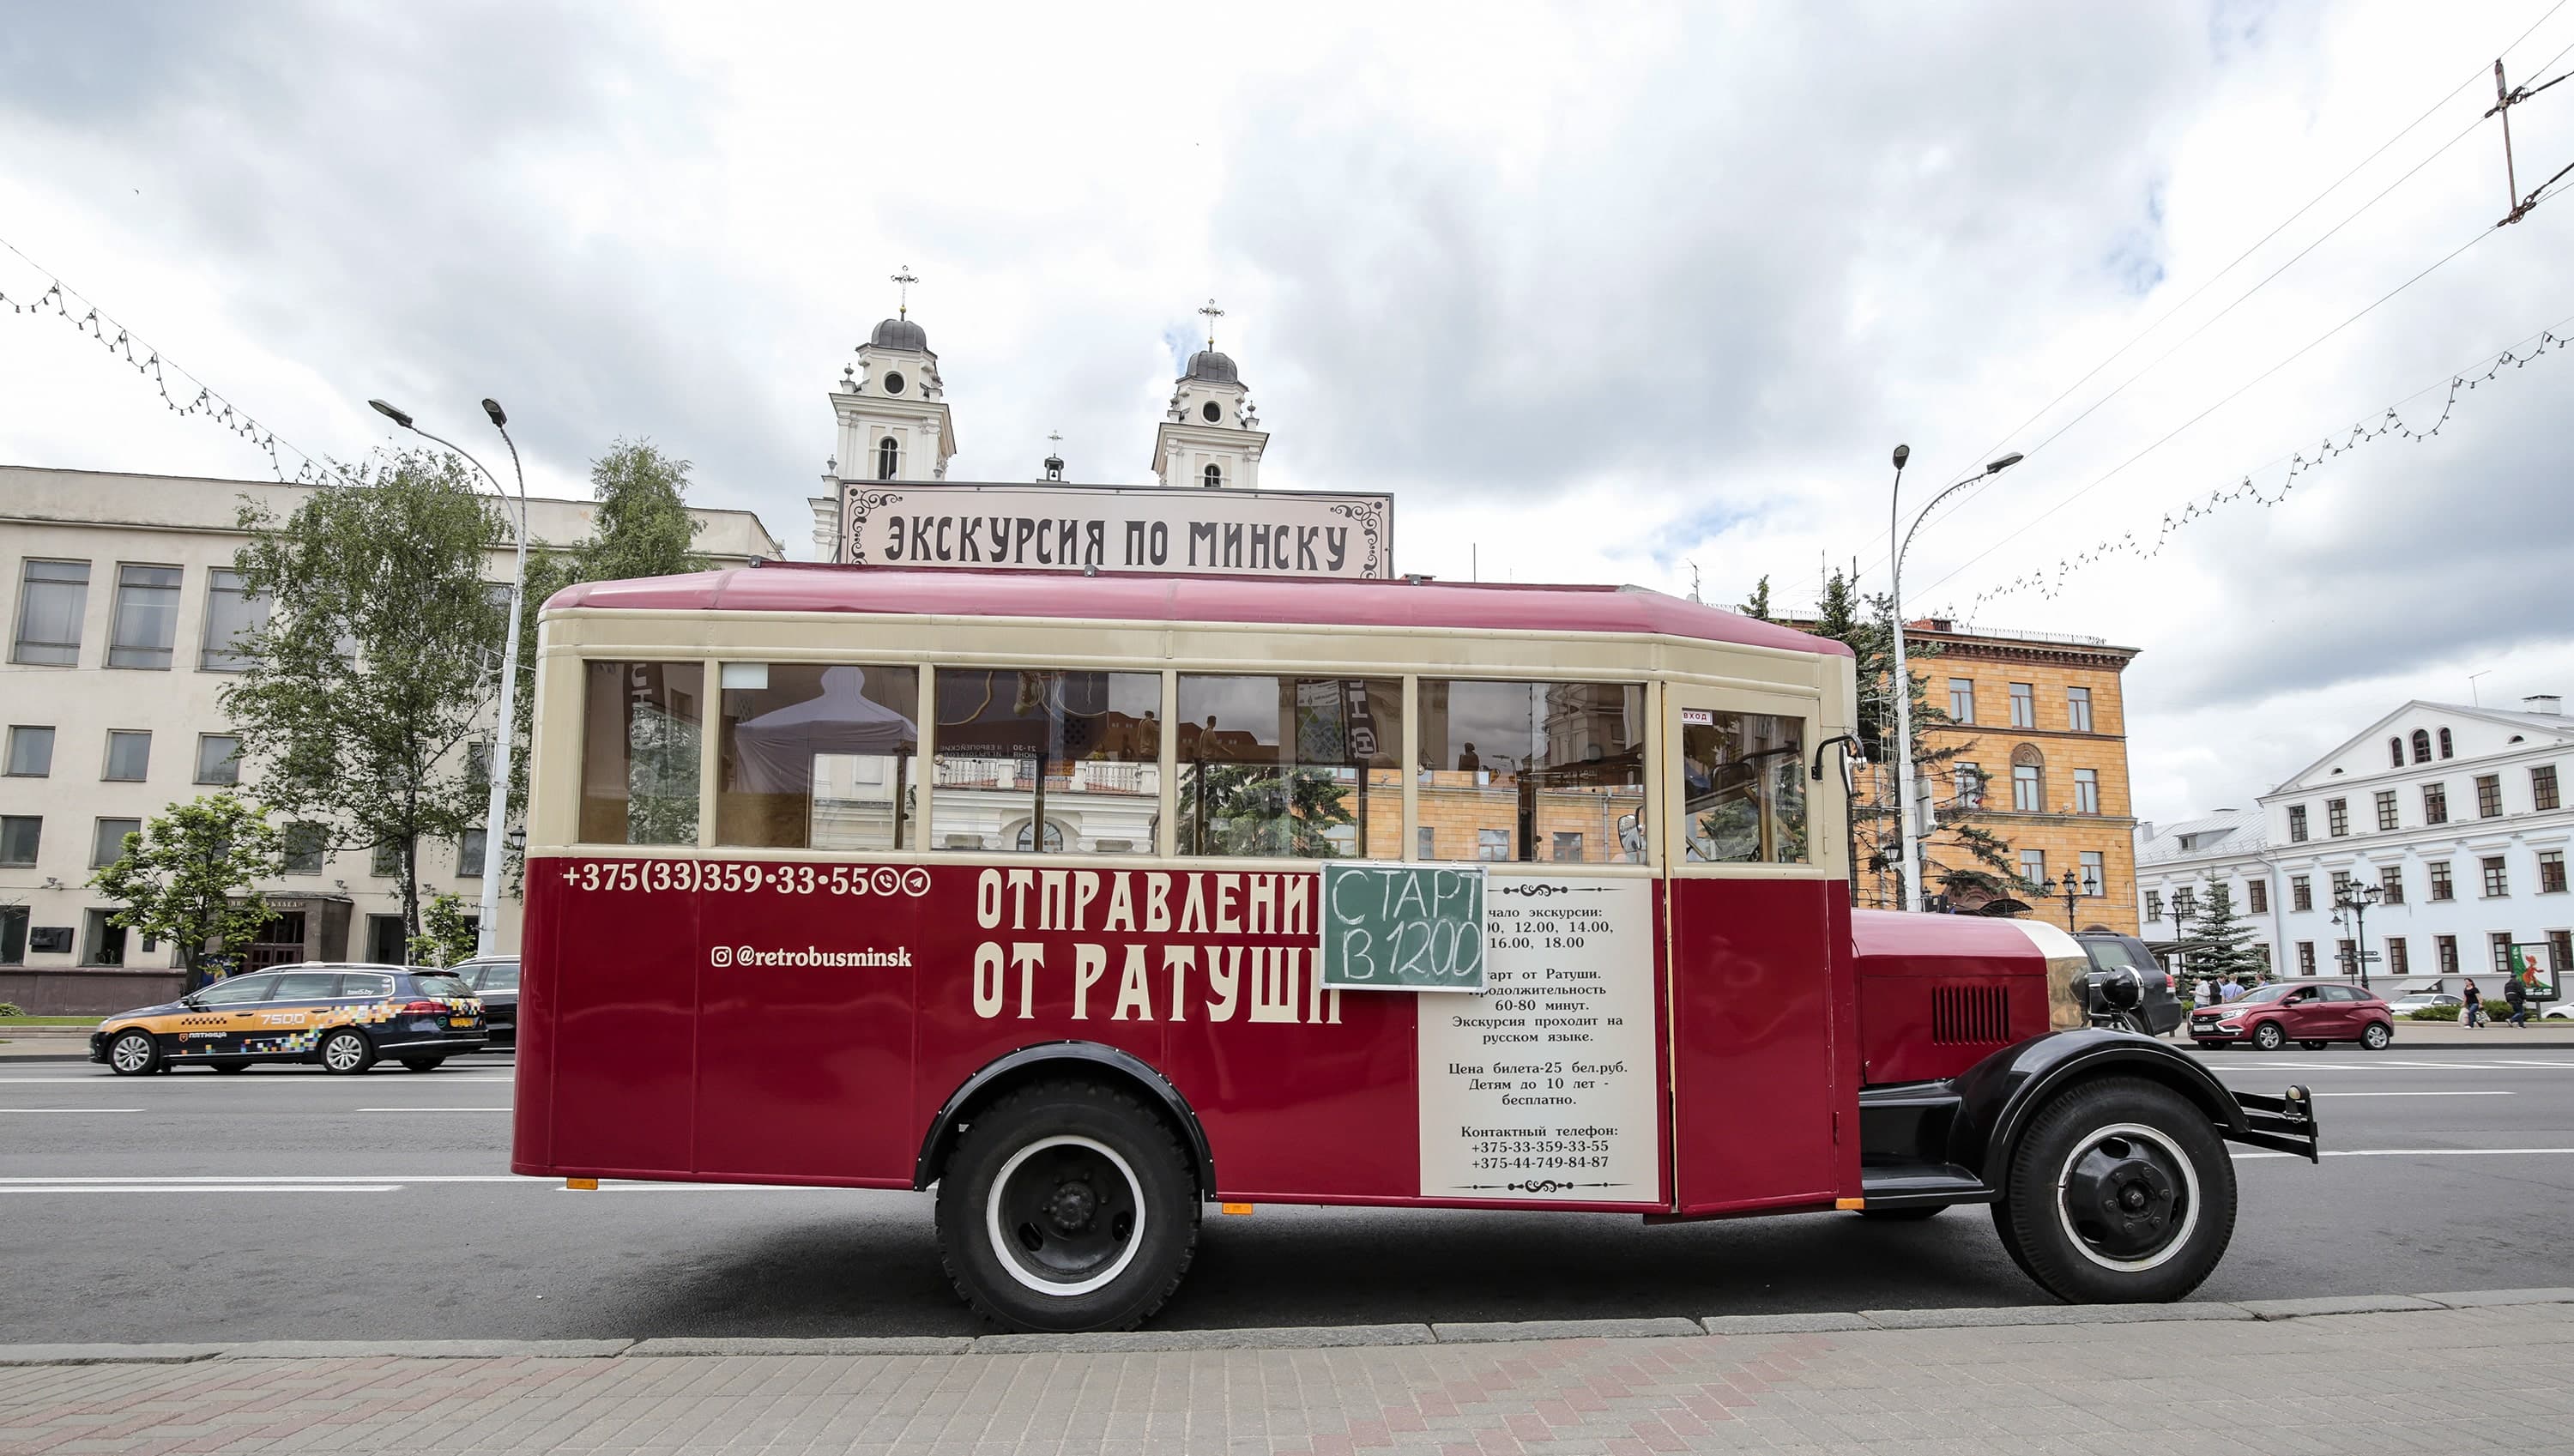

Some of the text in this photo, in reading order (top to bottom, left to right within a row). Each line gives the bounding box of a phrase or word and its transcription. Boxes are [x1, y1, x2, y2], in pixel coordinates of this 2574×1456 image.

[884, 516, 1349, 572] ЭКСКУРСИЯ ПО МИНСКУ
[1683, 712, 1707, 721] ВХОД
[977, 867, 1320, 935] ОТПРАВЛЕНИ
[1332, 868, 1483, 925] СТАРТ
[1489, 908, 1603, 919] чало экскурсии:
[1515, 921, 1559, 934] 12.00,
[1569, 921, 1614, 933] 14.00,
[1490, 936, 1585, 949] 16.00, 18.00
[736, 945, 912, 967] @retrobusminsk
[1342, 927, 1375, 980] В
[973, 941, 1046, 1021] ОТ
[1522, 971, 1538, 980] от
[1546, 968, 1601, 982] Ратуши.
[1495, 999, 1589, 1013] 60-80 минут.
[1452, 1015, 1623, 1030] Экскурсия проходит на
[1483, 1033, 1593, 1045] русском языке.
[1448, 1063, 1483, 1075] Цена
[1571, 1060, 1628, 1075] бел.руб.
[1468, 1078, 1511, 1090] Детям
[1520, 1081, 1537, 1090] до
[1548, 1077, 1564, 1090] 10
[1573, 1080, 1595, 1089] лет
[1502, 1093, 1577, 1106] бесплатно.
[1461, 1125, 1618, 1139] Контактный телефон:
[1471, 1139, 1609, 1154] +375-33-359-33-55
[1472, 1156, 1609, 1169] +375-44-749-84-87
